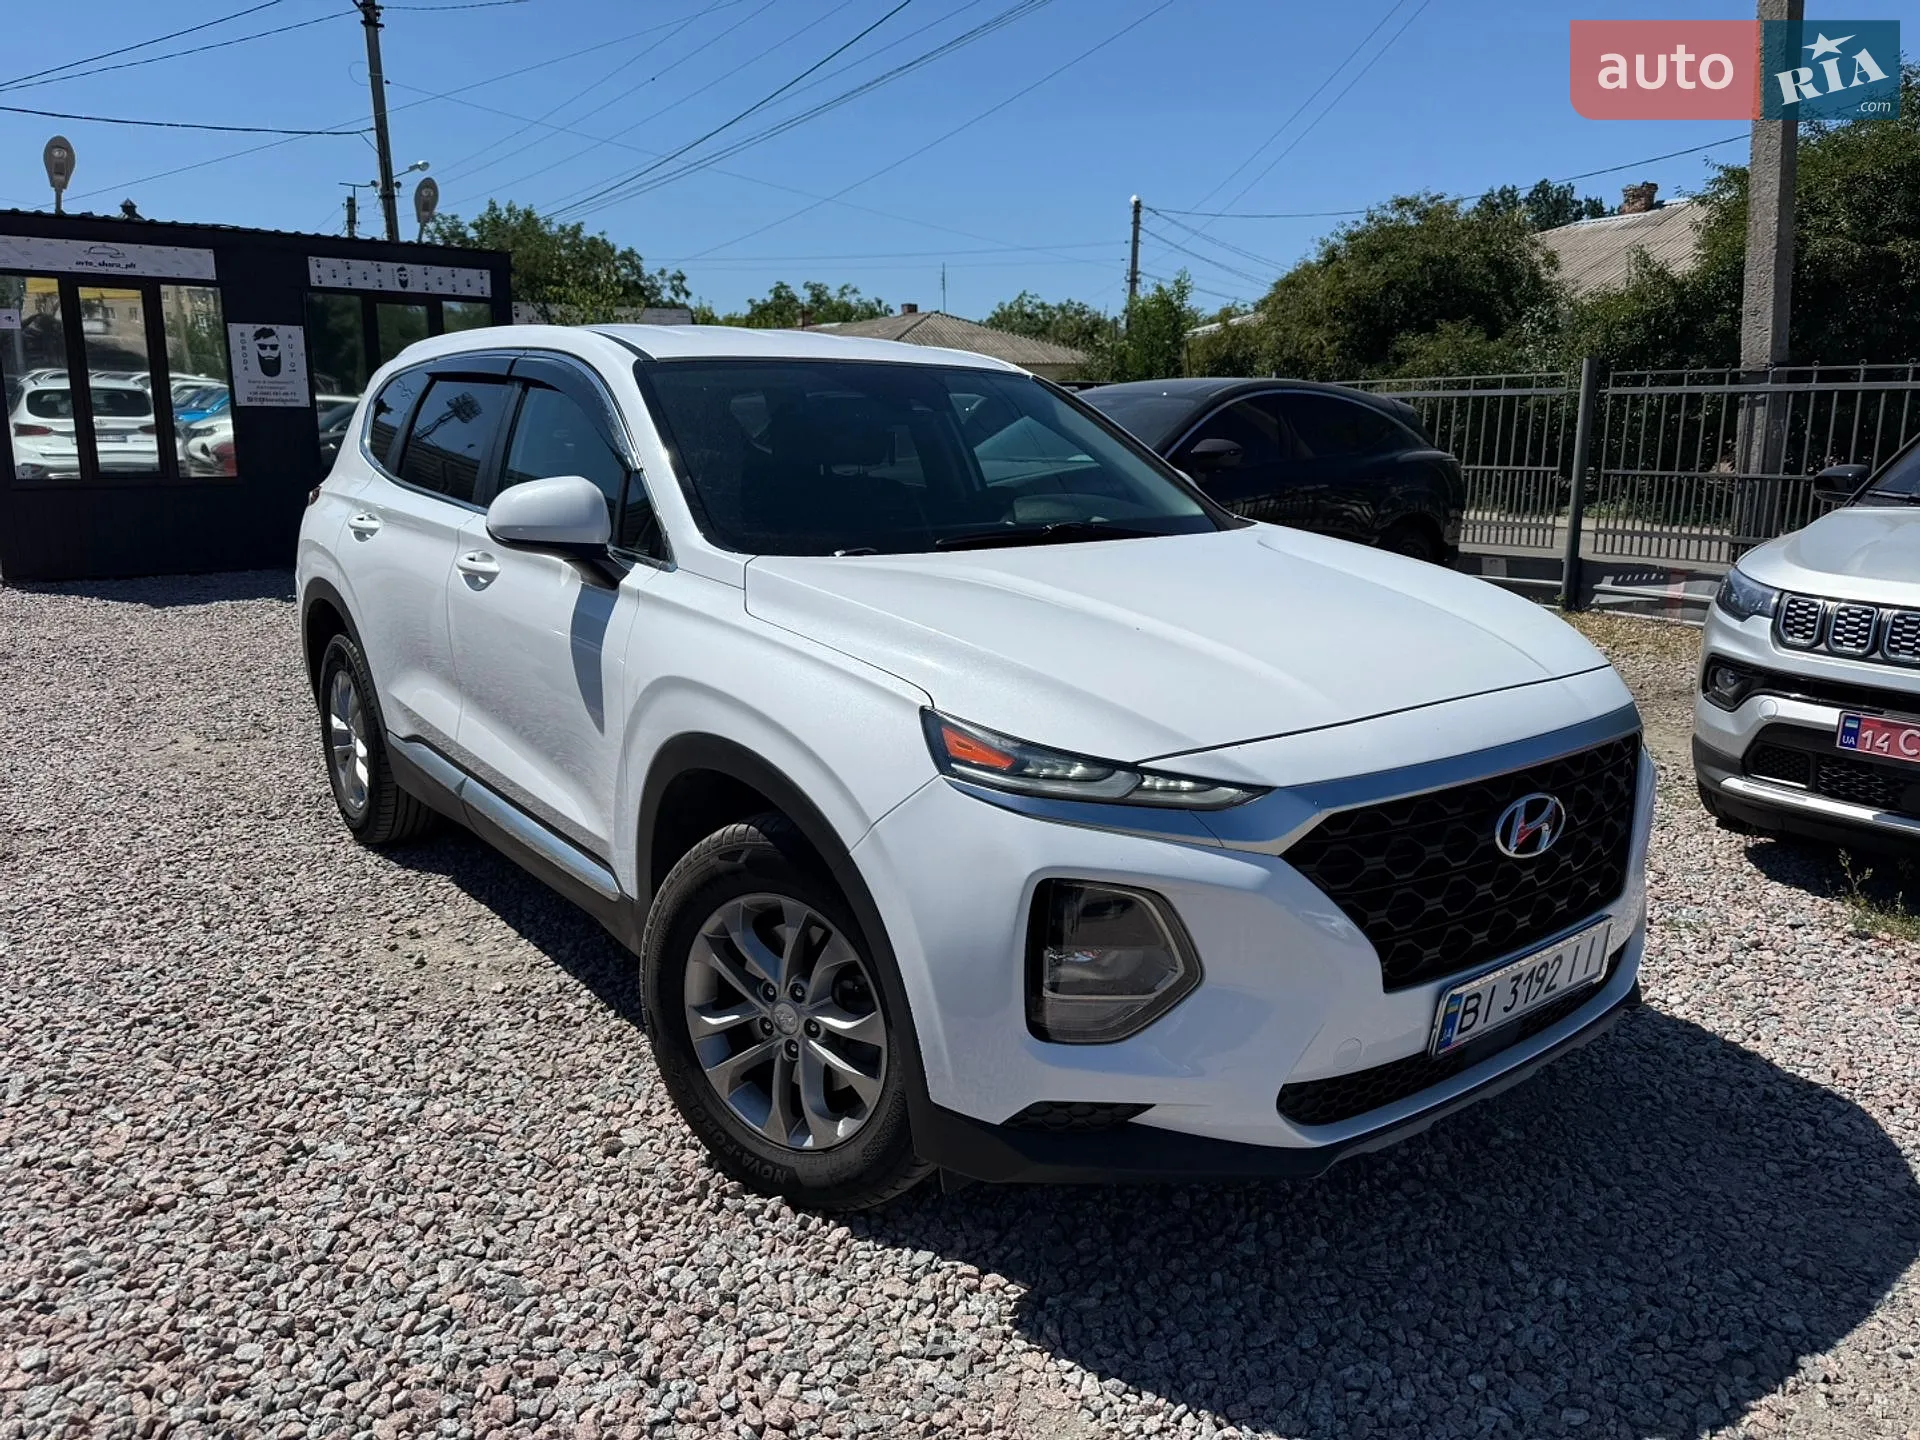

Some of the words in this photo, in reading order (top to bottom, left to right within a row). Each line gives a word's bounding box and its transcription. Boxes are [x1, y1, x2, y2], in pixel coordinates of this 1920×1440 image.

[239, 331, 249, 372] BORODA
[1842, 735, 1856, 746] UA
[1861, 729, 1890, 753] 14
[1456, 984, 1497, 1036] BI
[1502, 953, 1564, 1014] 3192
